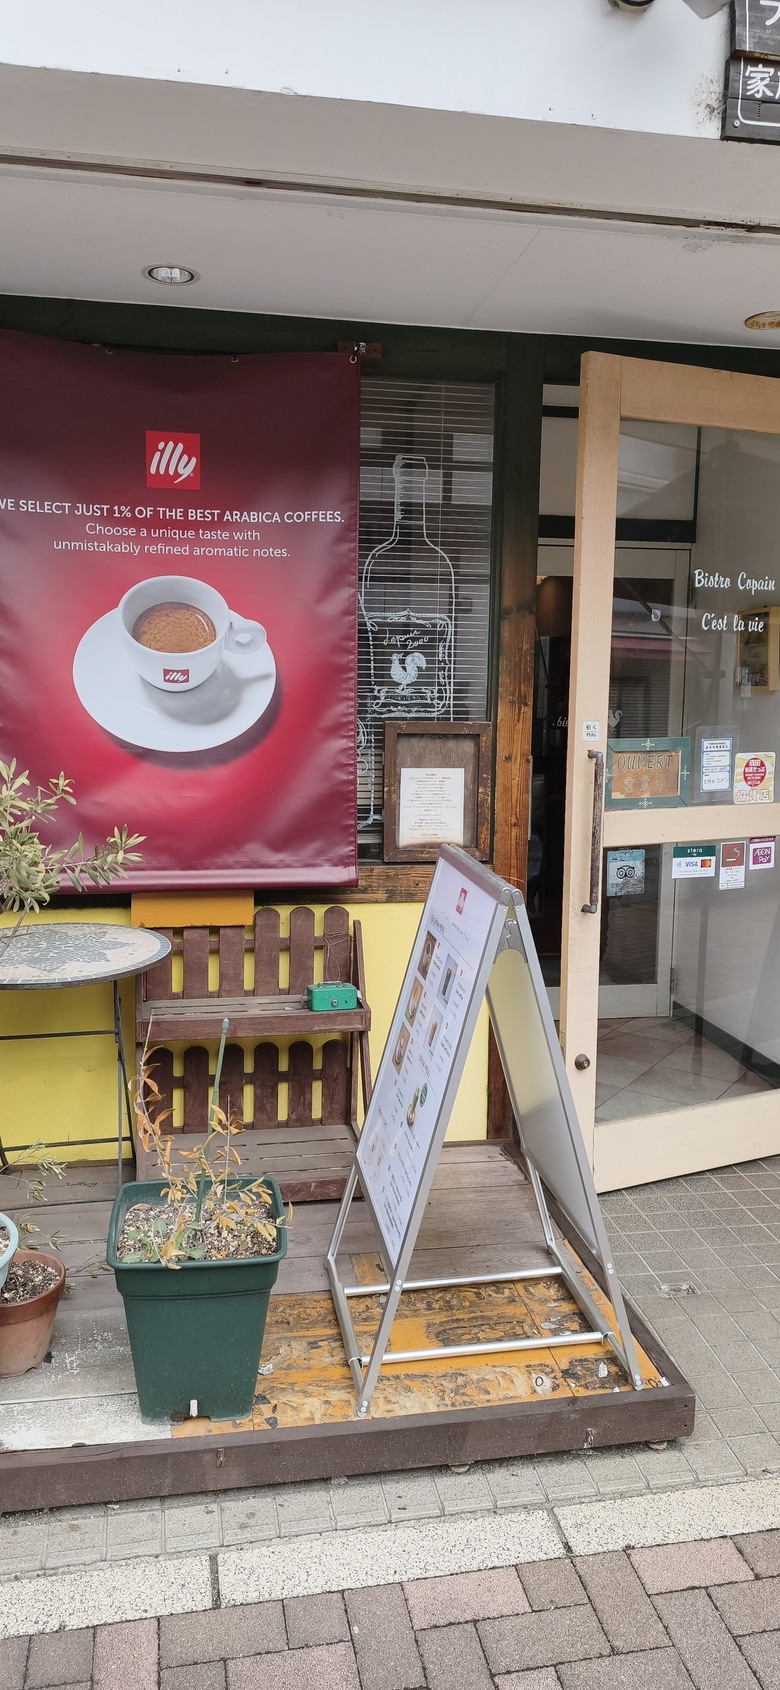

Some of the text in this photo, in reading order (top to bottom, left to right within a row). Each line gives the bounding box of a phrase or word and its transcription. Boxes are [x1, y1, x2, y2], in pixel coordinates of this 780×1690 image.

[745, 63, 780, 99] 家
[149, 440, 197, 484] illy
[19, 499, 71, 515] SELECT
[75, 503, 110, 517] JUST
[113, 505, 131, 518] 1%
[135, 506, 154, 519] OF
[157, 507, 184, 520] THE
[188, 509, 220, 522] BEST
[223, 510, 281, 523] ARABICA
[284, 510, 345, 523] COFFEES.
[85, 522, 261, 541] Choose a unique taste with
[53, 539, 291, 558] unmistakably refined aromatic notes.
[694, 569, 776, 596] Bistro Copain
[733, 614, 746, 632] la
[748, 616, 765, 633] vie
[164, 671, 188, 683] illy
[685, 860, 698, 868] VISA
